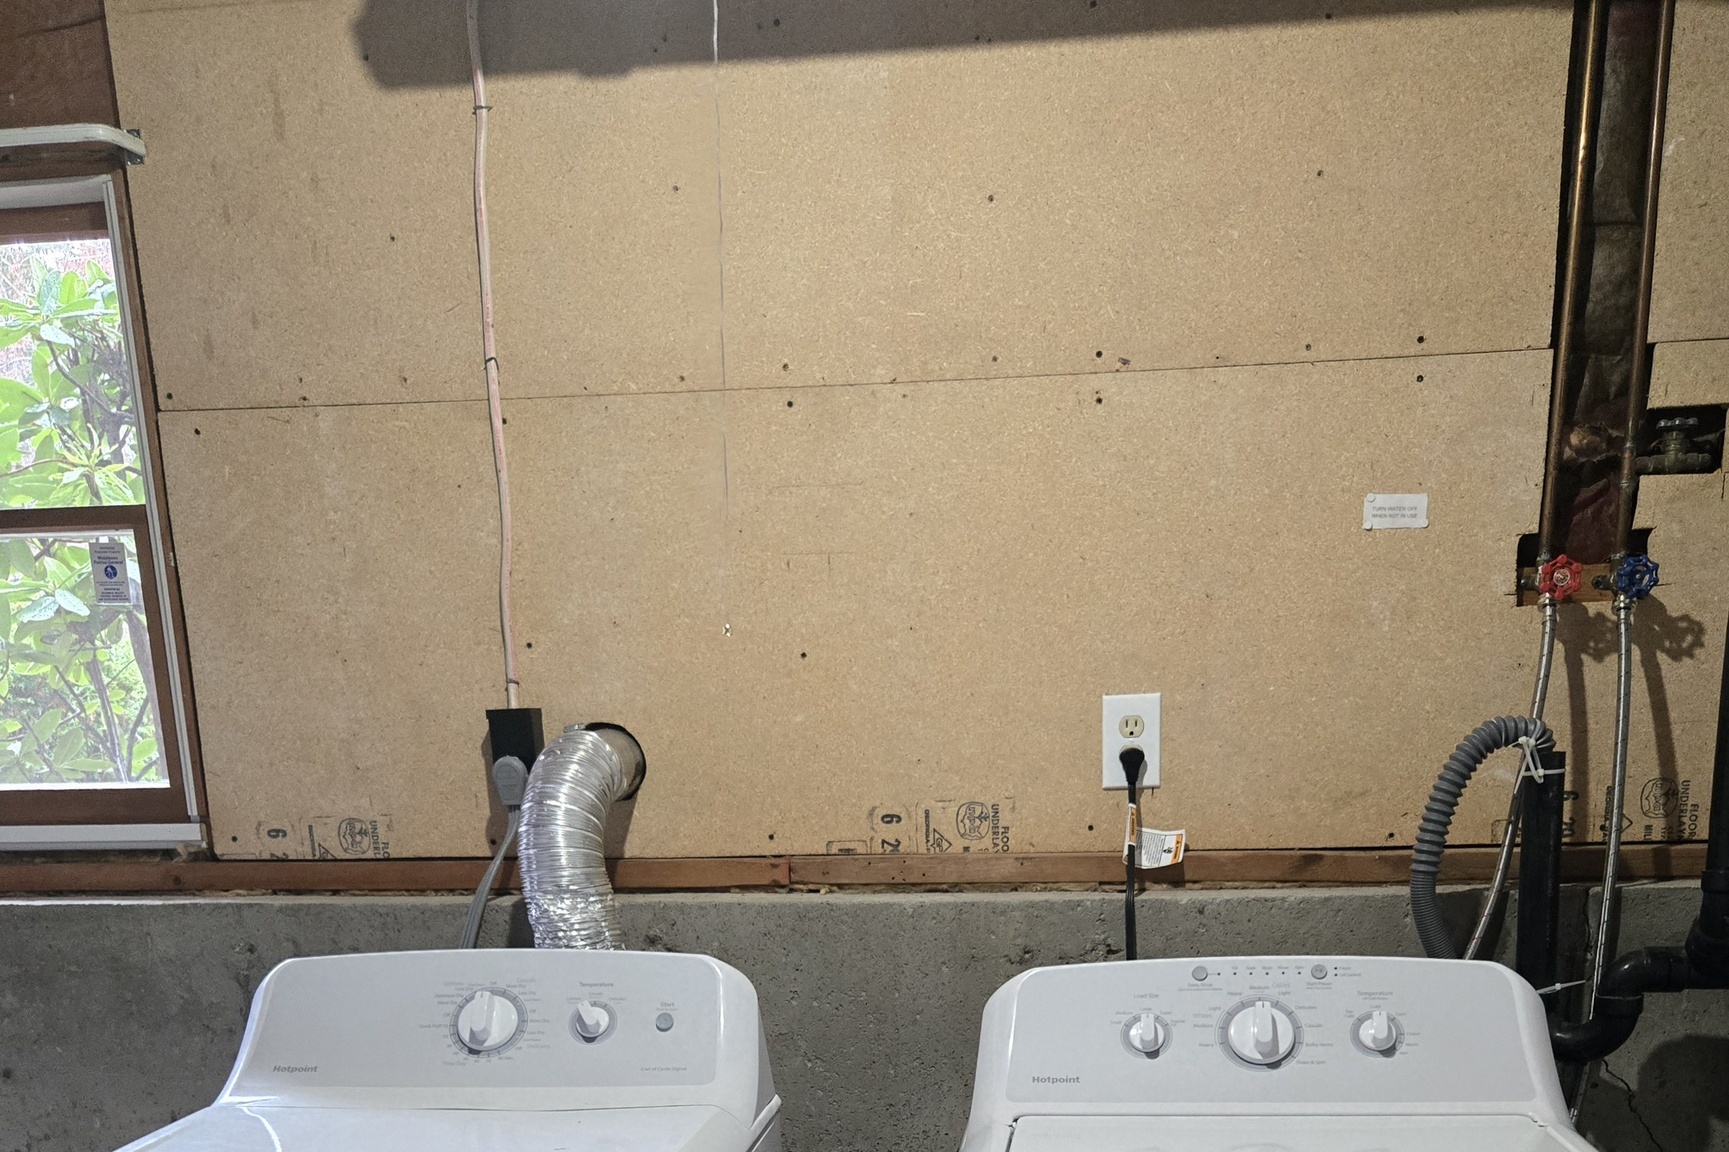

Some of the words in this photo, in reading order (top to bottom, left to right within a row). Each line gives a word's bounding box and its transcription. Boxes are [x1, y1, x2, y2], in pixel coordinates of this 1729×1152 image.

[881, 813, 902, 825] 6
[267, 828, 287, 839] 6
[272, 1065, 318, 1074] Hotpoint
[1032, 1076, 1080, 1085] Hotpoint
